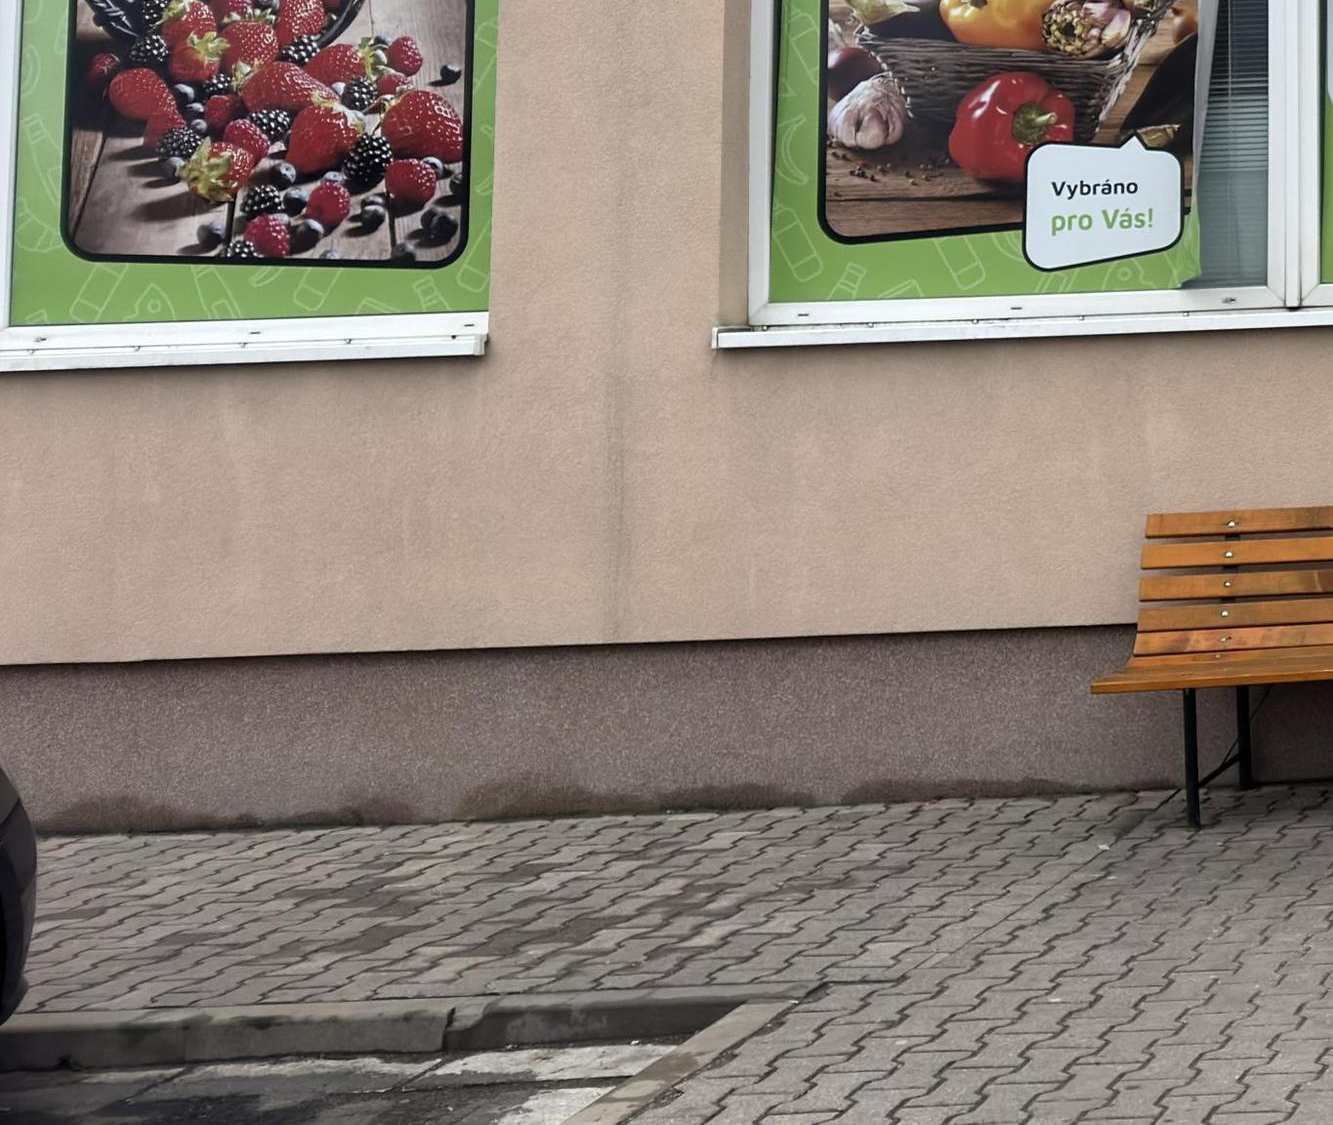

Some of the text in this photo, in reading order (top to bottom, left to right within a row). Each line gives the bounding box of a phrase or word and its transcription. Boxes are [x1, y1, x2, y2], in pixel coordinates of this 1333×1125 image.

[1051, 178, 1139, 200] Vybráno
[1051, 207, 1155, 236] pro Vás!
